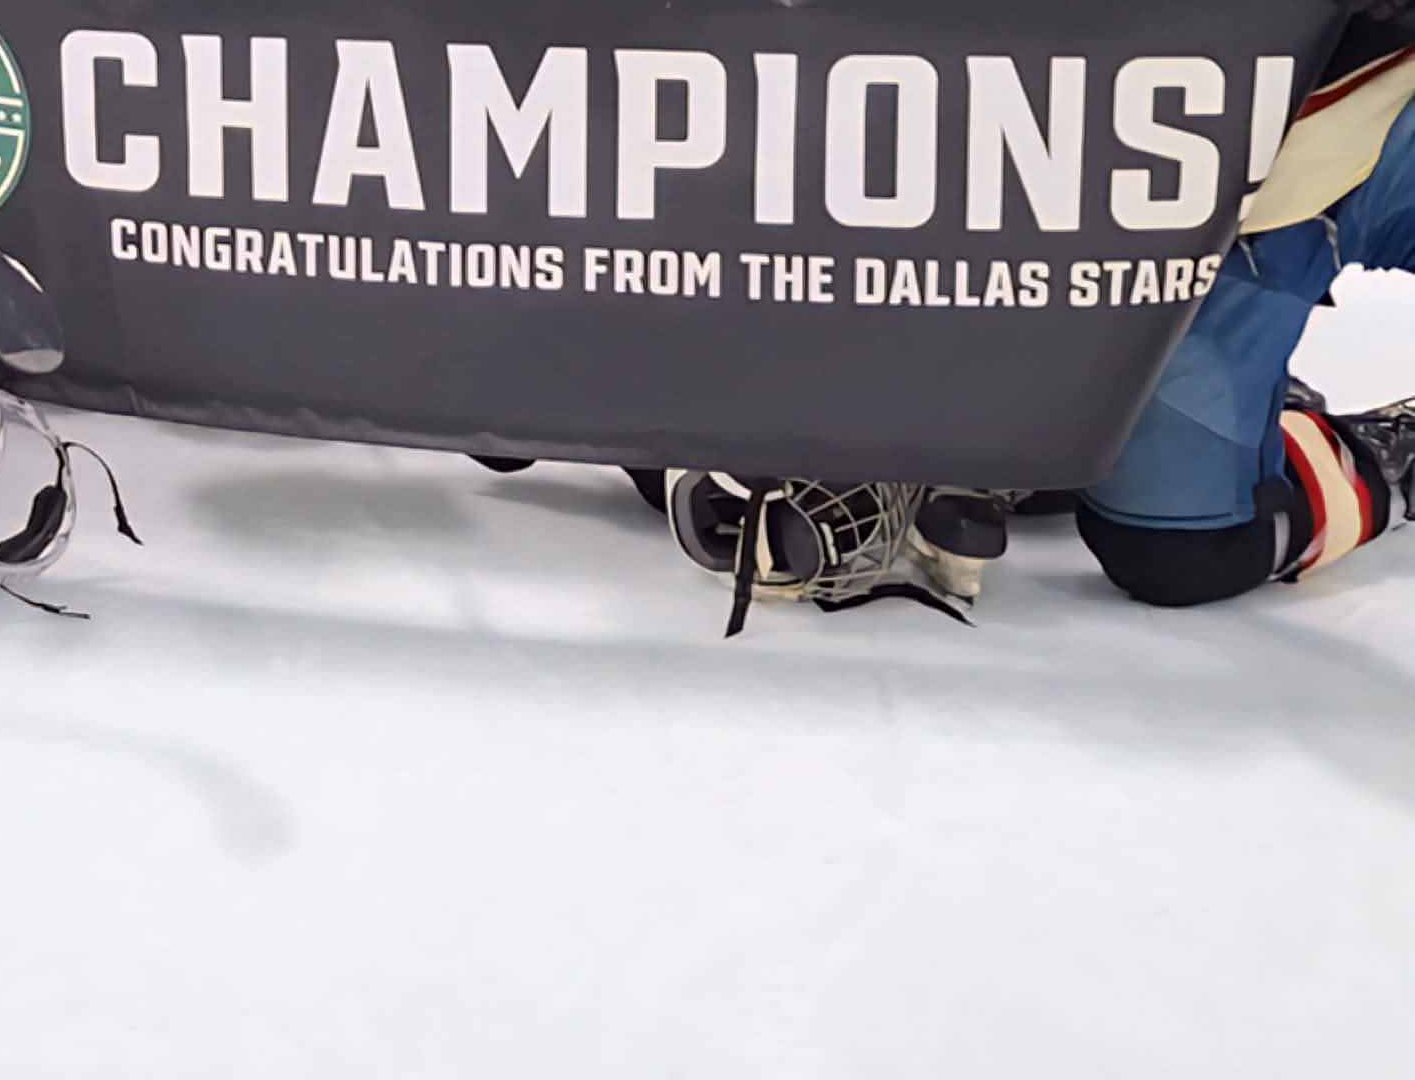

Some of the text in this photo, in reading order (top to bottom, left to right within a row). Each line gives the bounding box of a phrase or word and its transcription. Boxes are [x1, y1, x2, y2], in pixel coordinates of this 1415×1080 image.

[60, 29, 1294, 233] CHAMPIONS!
[111, 218, 1223, 308] CONGRATULATIONS FROM THE DALLAS STARS
